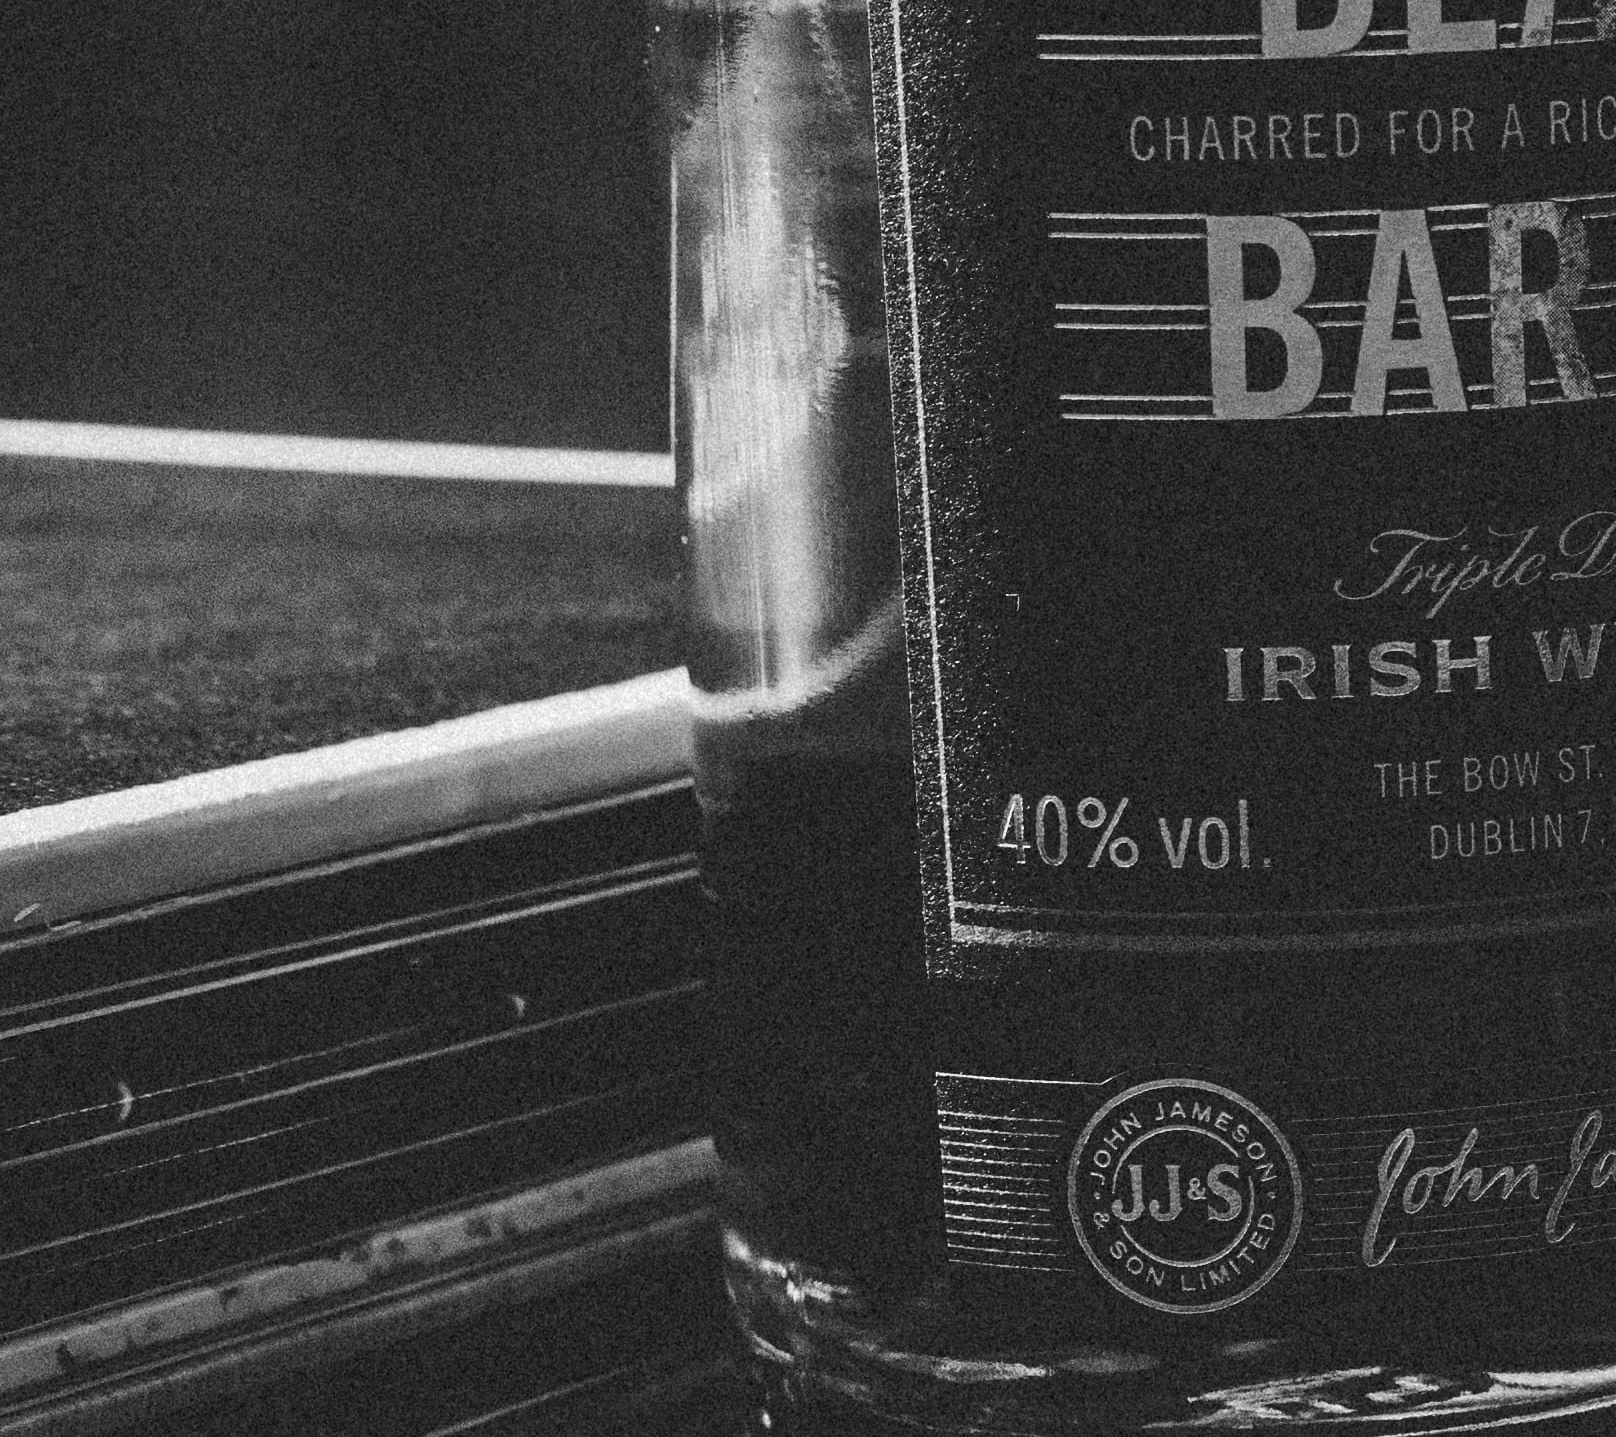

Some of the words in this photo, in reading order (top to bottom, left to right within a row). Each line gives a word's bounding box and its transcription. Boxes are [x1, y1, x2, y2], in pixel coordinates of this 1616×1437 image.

[1129, 112, 1361, 162] CHARRED
[1389, 108, 1476, 155] FOR
[1501, 103, 1526, 149] A
[1333, 525, 1546, 619] Triple
[1222, 635, 1495, 702] IRISH
[1373, 759, 1442, 798] THE
[1463, 750, 1541, 793] BOW
[1558, 744, 1604, 784] ST.
[997, 793, 1140, 867] 40%
[1158, 799, 1273, 869] vol.
[1430, 814, 1563, 860] DUBLIN
[1090, 1112, 1142, 1185] JOHN
[1155, 1101, 1278, 1182] JAMESON
[1111, 1163, 1243, 1222] JJ&S
[1362, 1127, 1540, 1268] John
[1109, 1240, 1165, 1287] SON
[1180, 1214, 1276, 1292] LIMITED
